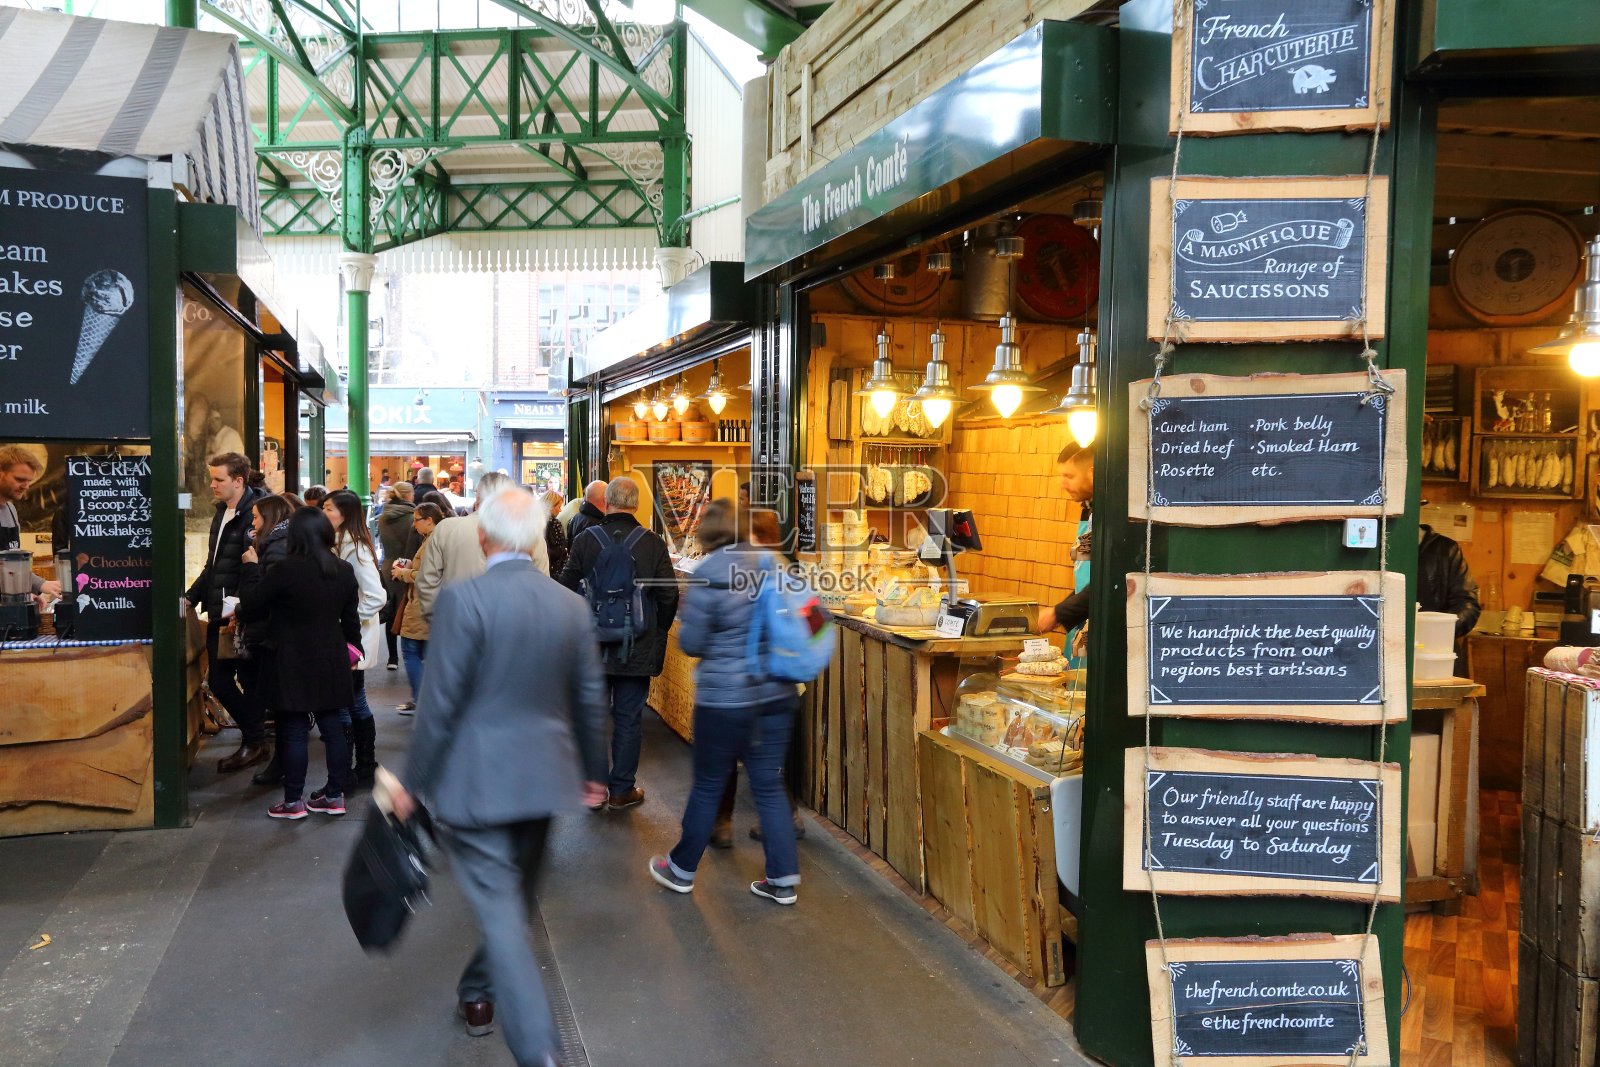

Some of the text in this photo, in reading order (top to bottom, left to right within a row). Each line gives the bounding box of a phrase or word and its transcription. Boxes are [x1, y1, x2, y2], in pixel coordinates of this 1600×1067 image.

[1200, 12, 1290, 45] French
[1197, 28, 1355, 91] CHARCUTERIE
[802, 132, 910, 235] The French Comté
[17, 190, 125, 215] PRODUCE
[1181, 225, 1332, 259] A MAGNIFIQUE
[1263, 255, 1346, 281] Range of
[0, 271, 64, 297] akes
[1190, 280, 1330, 299] SAUCISSONS
[0, 310, 34, 328] se
[5, 398, 50, 415] milk
[1160, 420, 1230, 434] Cured ham
[1255, 415, 1333, 437] Pork belly
[1160, 439, 1235, 460] Dried beef
[1257, 438, 1360, 455] Smoked Ham
[1160, 463, 1215, 477] Rosette
[1251, 463, 1283, 477] etc.
[83, 476, 140, 487] made with
[80, 487, 144, 500] organic milk
[79, 498, 85, 510] 1
[87, 501, 126, 512] scoop
[78, 510, 88, 523] 2
[88, 513, 128, 525] scoops
[74, 524, 152, 537] Milkshakes
[90, 556, 152, 568] Chocolate
[90, 597, 136, 610] Vanilla
[1160, 623, 1376, 649] We handpick the best quality
[1160, 643, 1334, 664] products from our
[1161, 661, 1347, 683] regions best artisans
[1162, 786, 1375, 822] Our friendly staff are happy
[1162, 811, 1370, 835] to answer all your questions
[1161, 832, 1352, 864] Tuesday to Saturday
[1185, 979, 1350, 1005] thefrenchcomte.co.uk
[1201, 1012, 1335, 1035] @thefrenchcomte
